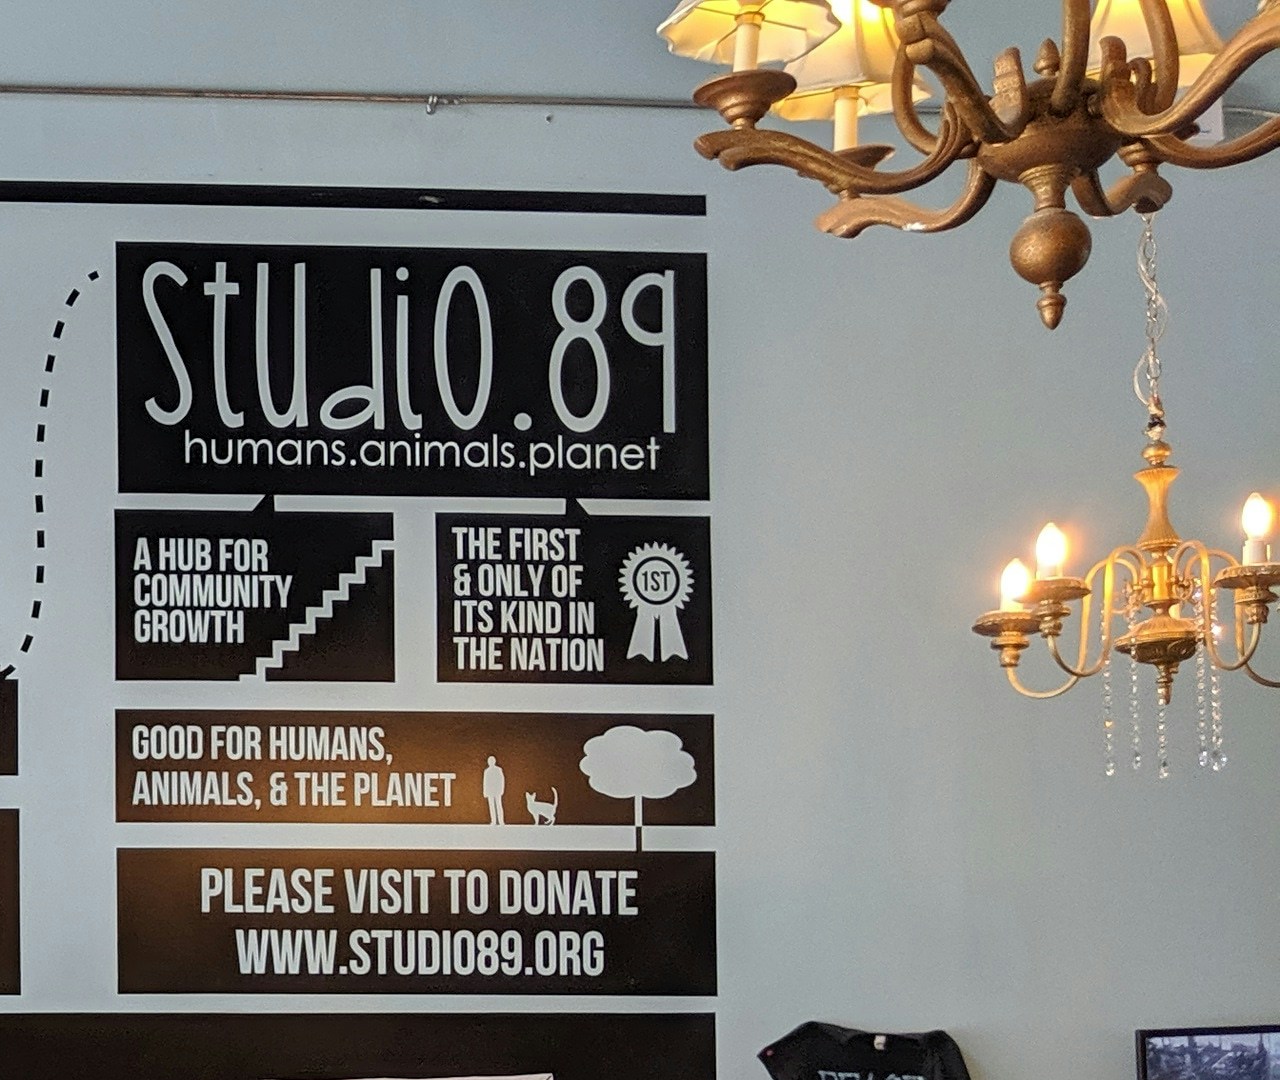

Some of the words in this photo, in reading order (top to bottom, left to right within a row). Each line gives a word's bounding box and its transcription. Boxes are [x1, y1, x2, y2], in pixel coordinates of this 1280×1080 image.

[185, 430, 659, 476] humans.animals.planet
[134, 538, 151, 570] A
[159, 538, 211, 571] HUB
[219, 539, 268, 571] FOR
[452, 527, 502, 560] THE
[510, 528, 580, 561] FIRST
[135, 574, 292, 607] COMMUNITY
[454, 564, 471, 596] &
[478, 564, 544, 596] ONLY
[552, 565, 583, 597] OF
[642, 571, 670, 591] 1ST
[135, 610, 244, 643] GROWTH
[454, 600, 493, 633] ITS
[501, 601, 561, 633] KIND
[570, 602, 594, 634] IN
[453, 637, 503, 670] THE
[511, 638, 603, 671] NATION
[133, 725, 203, 759] GOOD
[211, 726, 261, 760] FOR
[270, 727, 392, 765] HUMANS,
[133, 771, 261, 810] ANIMALS,
[270, 772, 288, 806] &
[294, 772, 346, 806] THE
[355, 773, 456, 806] PLANET
[202, 868, 334, 913] PLEASE
[344, 869, 435, 914] VISIT
[444, 870, 488, 914] TO
[500, 870, 638, 915] DONATE
[236, 930, 604, 976] WWW.STUDIO89.ORG
